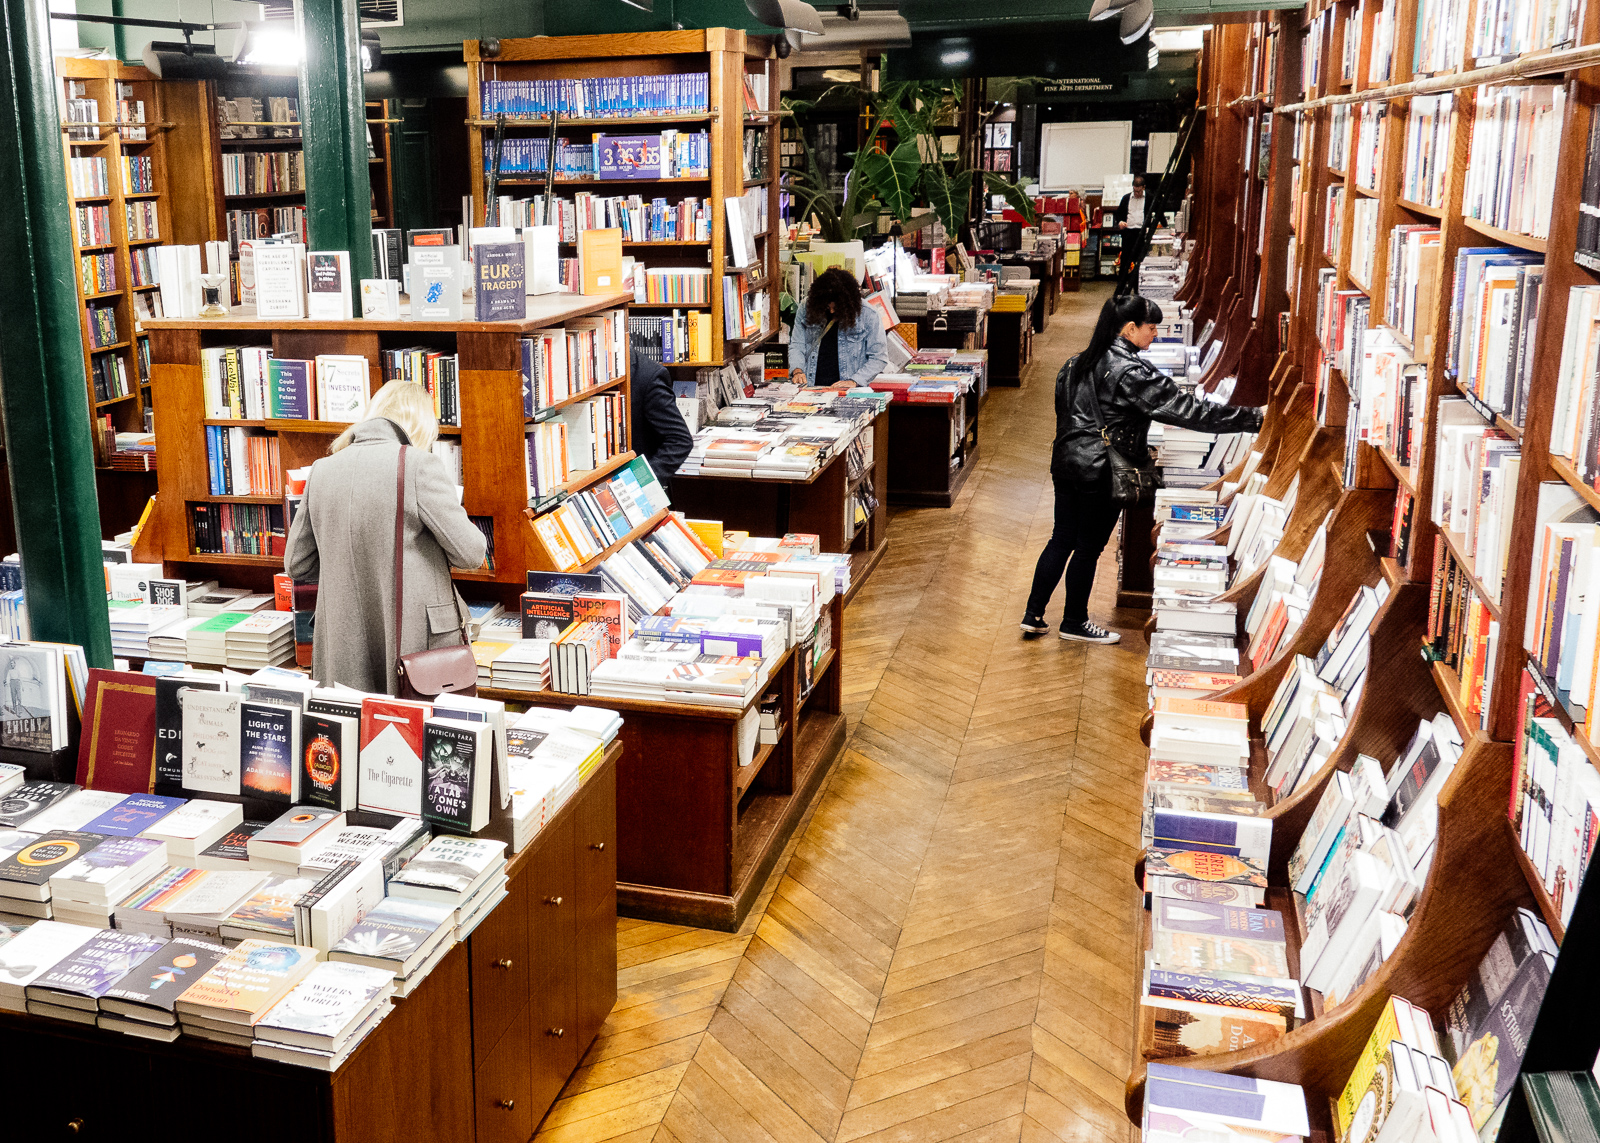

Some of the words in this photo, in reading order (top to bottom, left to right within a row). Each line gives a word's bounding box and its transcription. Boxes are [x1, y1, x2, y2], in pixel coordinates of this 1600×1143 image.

[603, 148, 614, 166] 3
[481, 280, 523, 291] TRAGEDY
[226, 352, 237, 393] LikeWar
[327, 364, 337, 383] 7
[116, 591, 131, 599] That
[154, 587, 175, 598] SHOE
[277, 593, 292, 604] Targ
[156, 596, 174, 606] DOG
[573, 597, 606, 610] Super
[526, 609, 571, 618] INTELLIGENCE
[531, 604, 565, 612] ARTIFICIAL
[251, 612, 289, 621] Don't
[573, 611, 621, 626] Pumped
[244, 621, 270, 629] evil
[199, 718, 224, 727] ANIMALS
[248, 720, 271, 730] LIGHT
[273, 723, 284, 731] OF
[158, 728, 182, 740] EDI
[245, 730, 261, 739] THE
[262, 733, 287, 743] STARS
[318, 733, 329, 744] THE
[428, 728, 455, 739] PATRICIA
[457, 732, 473, 742] FARA
[312, 742, 335, 756] ORIGIN
[318, 754, 328, 763] OF
[246, 767, 264, 775] ADAM
[265, 769, 286, 778] FRANK
[368, 768, 380, 781] The
[381, 769, 413, 788] Cigarette
[16, 786, 63, 796] SHADOW
[312, 779, 333, 792] THING
[9, 792, 48, 801] DOUBT
[434, 786, 440, 794] A
[443, 788, 461, 799] LAB
[126, 800, 168, 810] DAWKINS
[428, 794, 438, 803] of
[438, 796, 467, 809] ONE'S
[113, 807, 157, 819] Outgrowing
[435, 805, 458, 817] OWN
[112, 814, 138, 823] God
[339, 831, 353, 839] WE
[352, 832, 372, 840] ARE
[118, 839, 145, 847] NEIL
[337, 838, 374, 848] WEATHE
[441, 838, 488, 850] GODS
[102, 848, 136, 856] TYSON
[319, 851, 360, 861] JONATHA
[430, 846, 484, 859] UPPER
[435, 853, 465, 863] AIR
[308, 856, 340, 865] SAFRAN
[1194, 852, 1209, 876] STATE
[1209, 853, 1226, 878] GREAT
[1212, 885, 1227, 898] SILK
[359, 919, 427, 936] Irreplaceable
[1249, 912, 1267, 933] IRAN
[94, 940, 138, 953] DEEPLY
[243, 940, 260, 950] The
[261, 944, 290, 954] Case
[226, 954, 261, 965] Reality
[235, 948, 270, 959] Against
[67, 964, 101, 975] SEAN
[217, 962, 243, 972] How
[242, 966, 289, 979] evolution
[46, 971, 100, 986] CARROLL
[209, 969, 226, 978] hid
[226, 971, 243, 979] the
[243, 973, 271, 984] truth
[192, 984, 229, 995] Donald
[200, 977, 225, 986] from
[226, 980, 244, 988] our
[244, 983, 270, 993] eyes
[312, 984, 353, 996] WATERS
[125, 990, 150, 1001] VINCE
[184, 991, 229, 1004] Hoffman
[303, 995, 342, 1007] WORLD
[1500, 1000, 1528, 1057] SCYTHIANS
